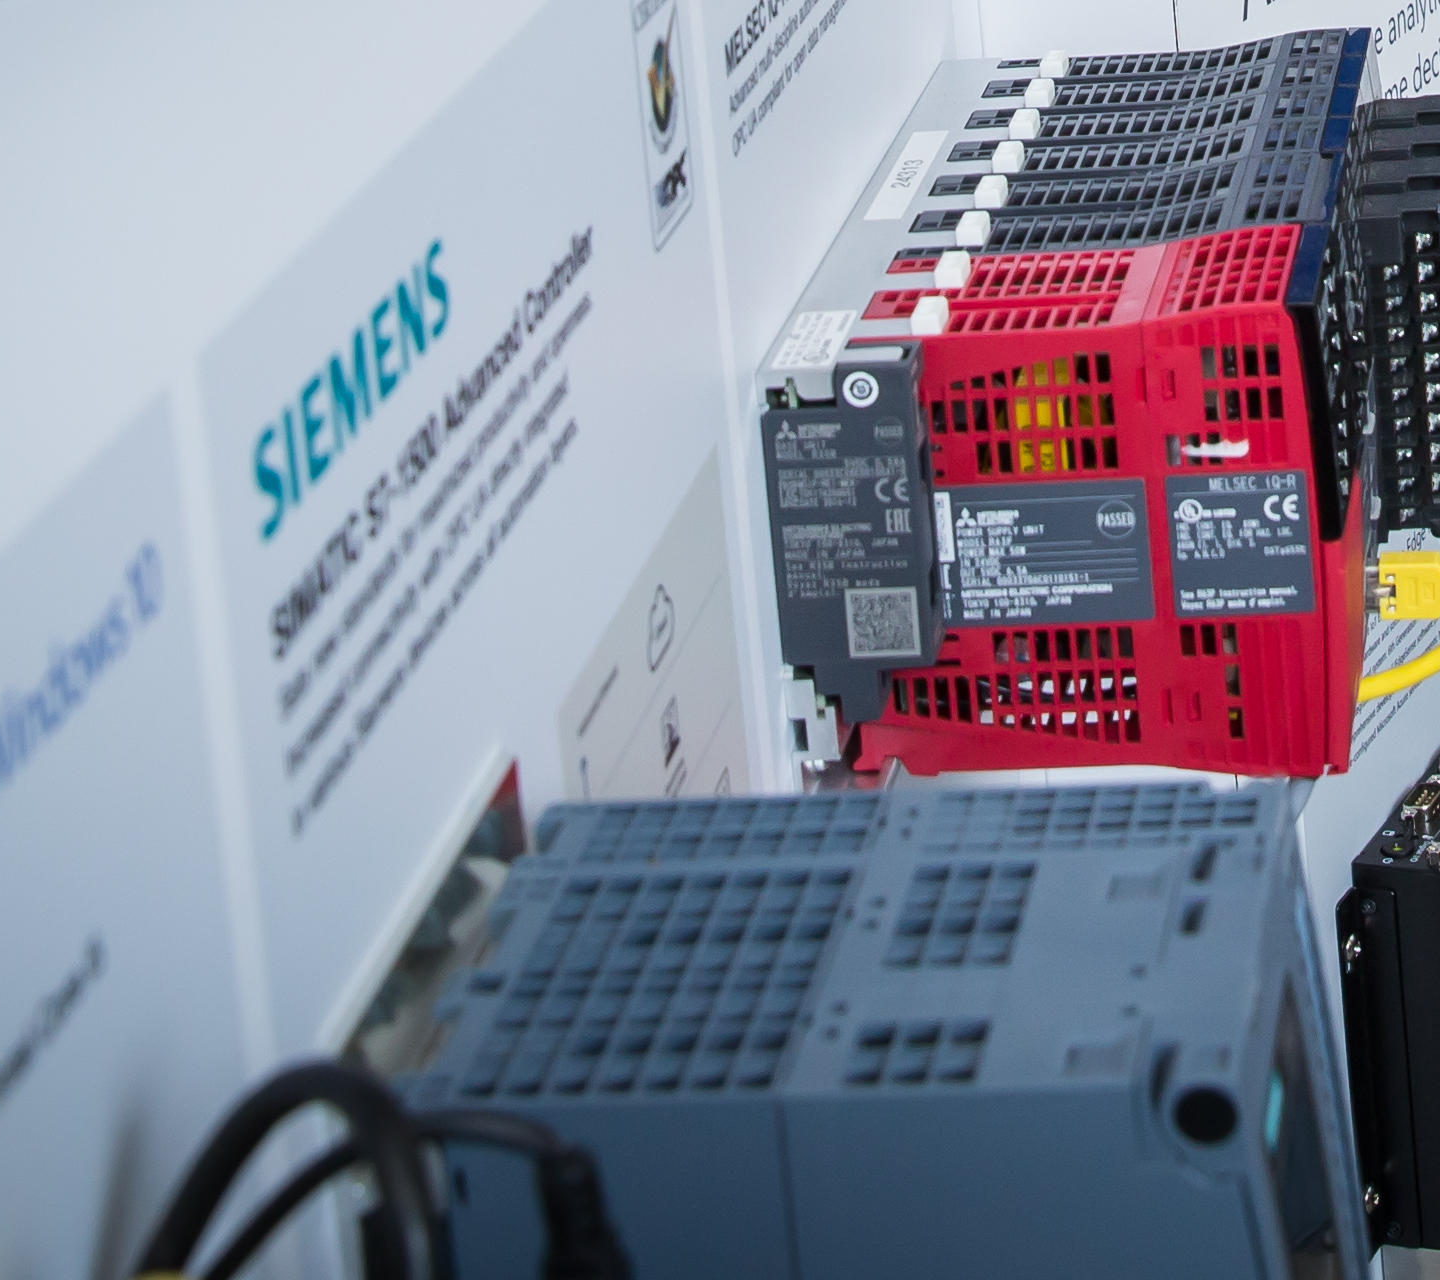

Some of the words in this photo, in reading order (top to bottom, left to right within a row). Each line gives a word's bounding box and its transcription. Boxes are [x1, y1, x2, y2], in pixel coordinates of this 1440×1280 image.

[729, 69, 759, 119] Advanced
[891, 159, 923, 188] 24313
[251, 239, 451, 541] SIEMENS
[1209, 476, 1256, 490] MELSEC
[1097, 511, 1134, 528] PASSED
